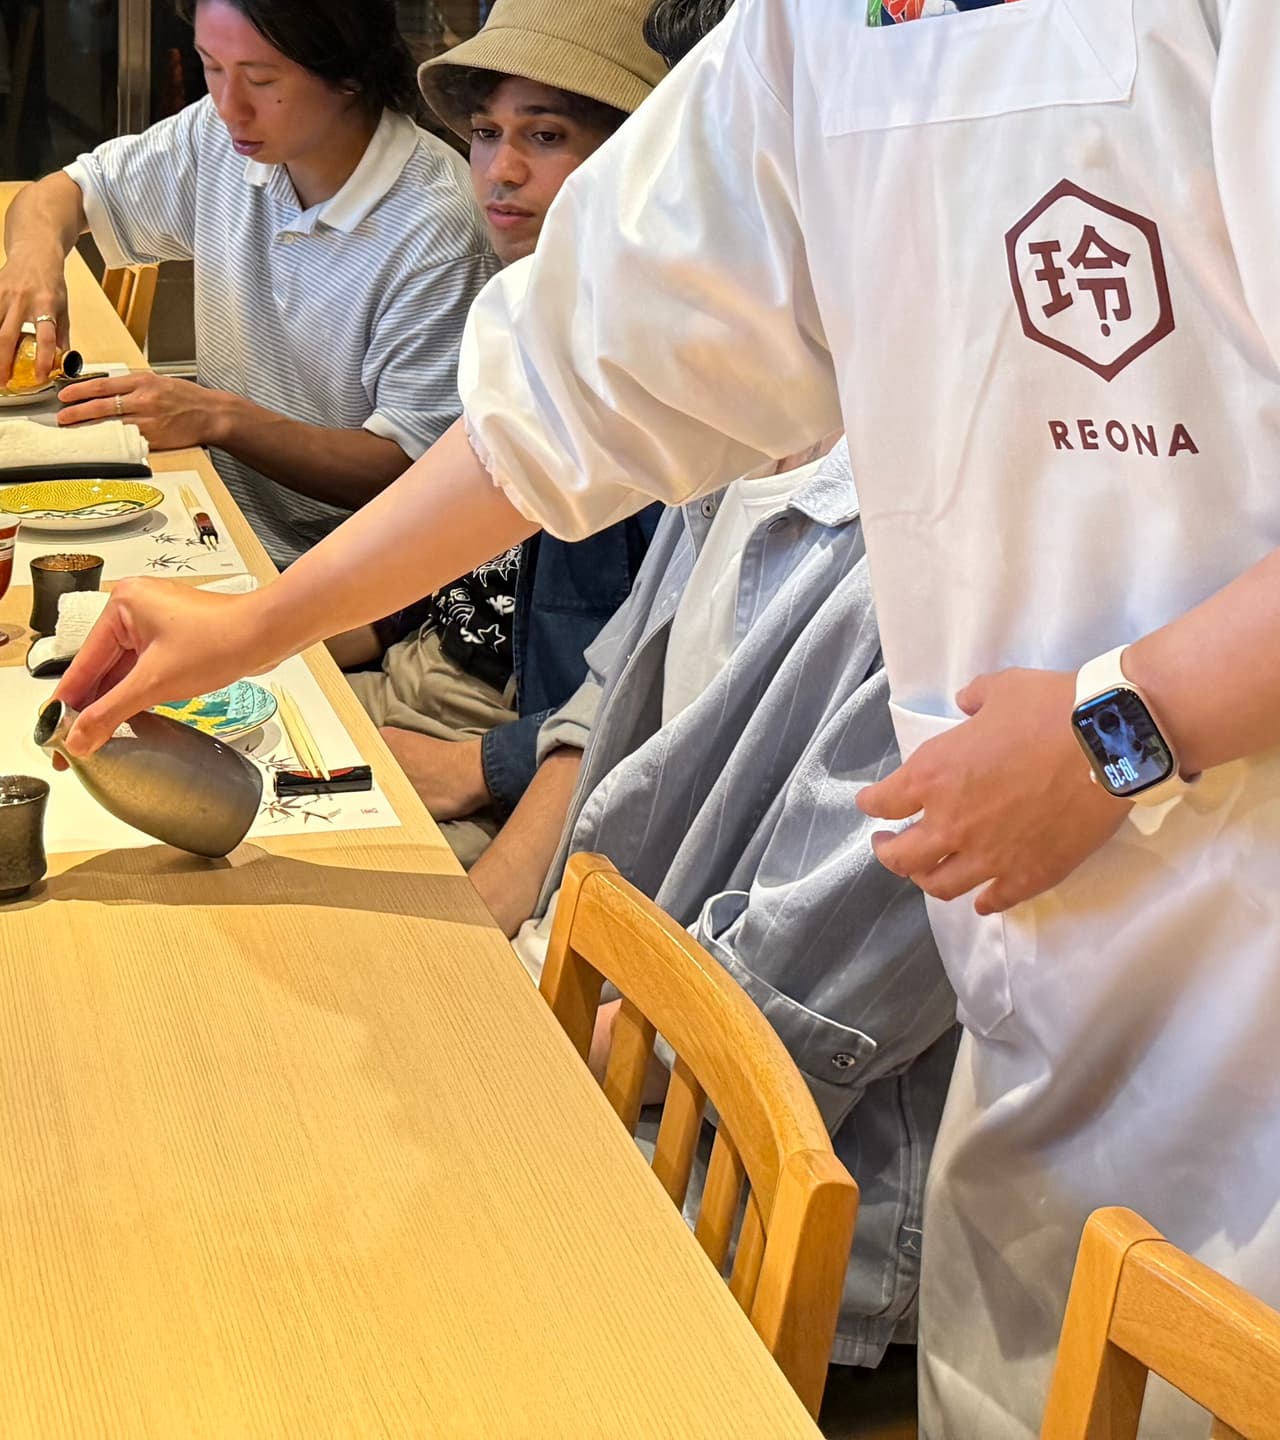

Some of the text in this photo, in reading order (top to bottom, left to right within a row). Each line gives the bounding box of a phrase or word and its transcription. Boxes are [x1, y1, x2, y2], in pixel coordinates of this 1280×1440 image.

[1028, 225, 1132, 337] 玲
[1048, 419, 1200, 457] REONA
[1104, 756, 1139, 788] 19:13
